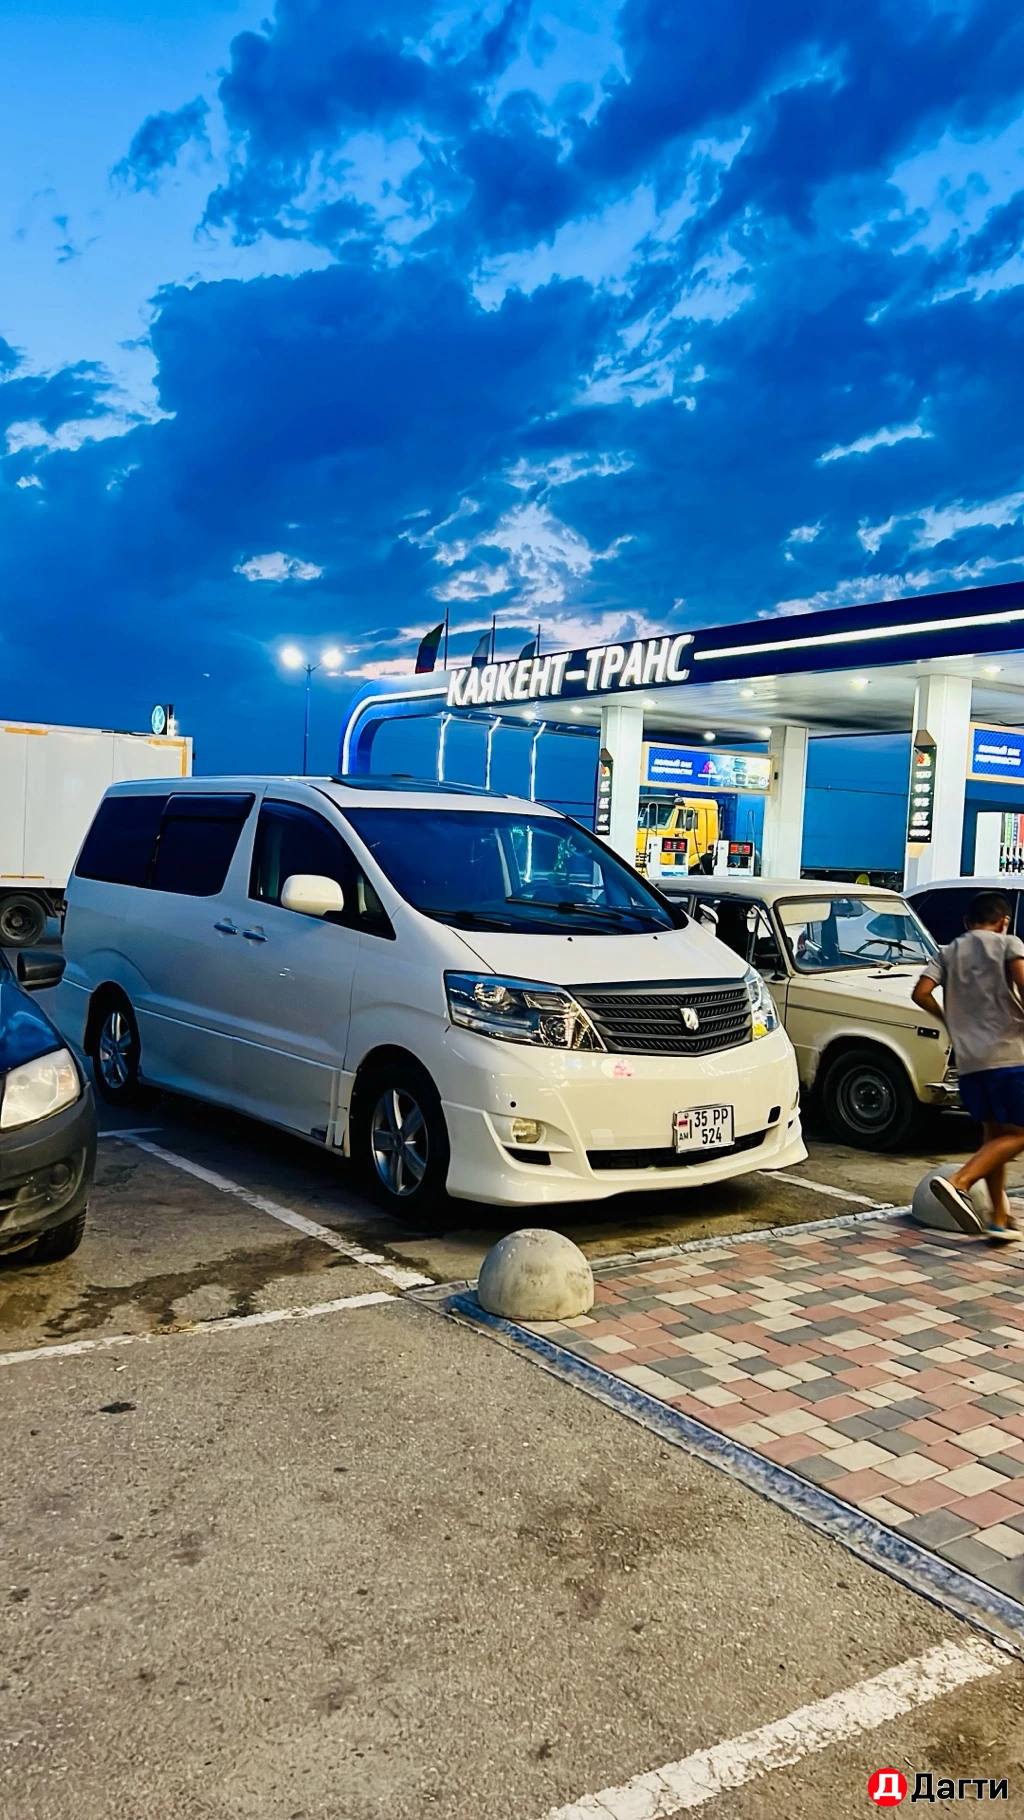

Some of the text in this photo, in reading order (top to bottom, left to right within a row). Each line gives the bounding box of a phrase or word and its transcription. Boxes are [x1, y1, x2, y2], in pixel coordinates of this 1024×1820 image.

[447, 634, 694, 706] КАЯКЕНТ-ТРАНС
[694, 1108, 728, 1127] 35 PP
[679, 1132, 689, 1141] AM
[702, 1127, 722, 1144] 524
